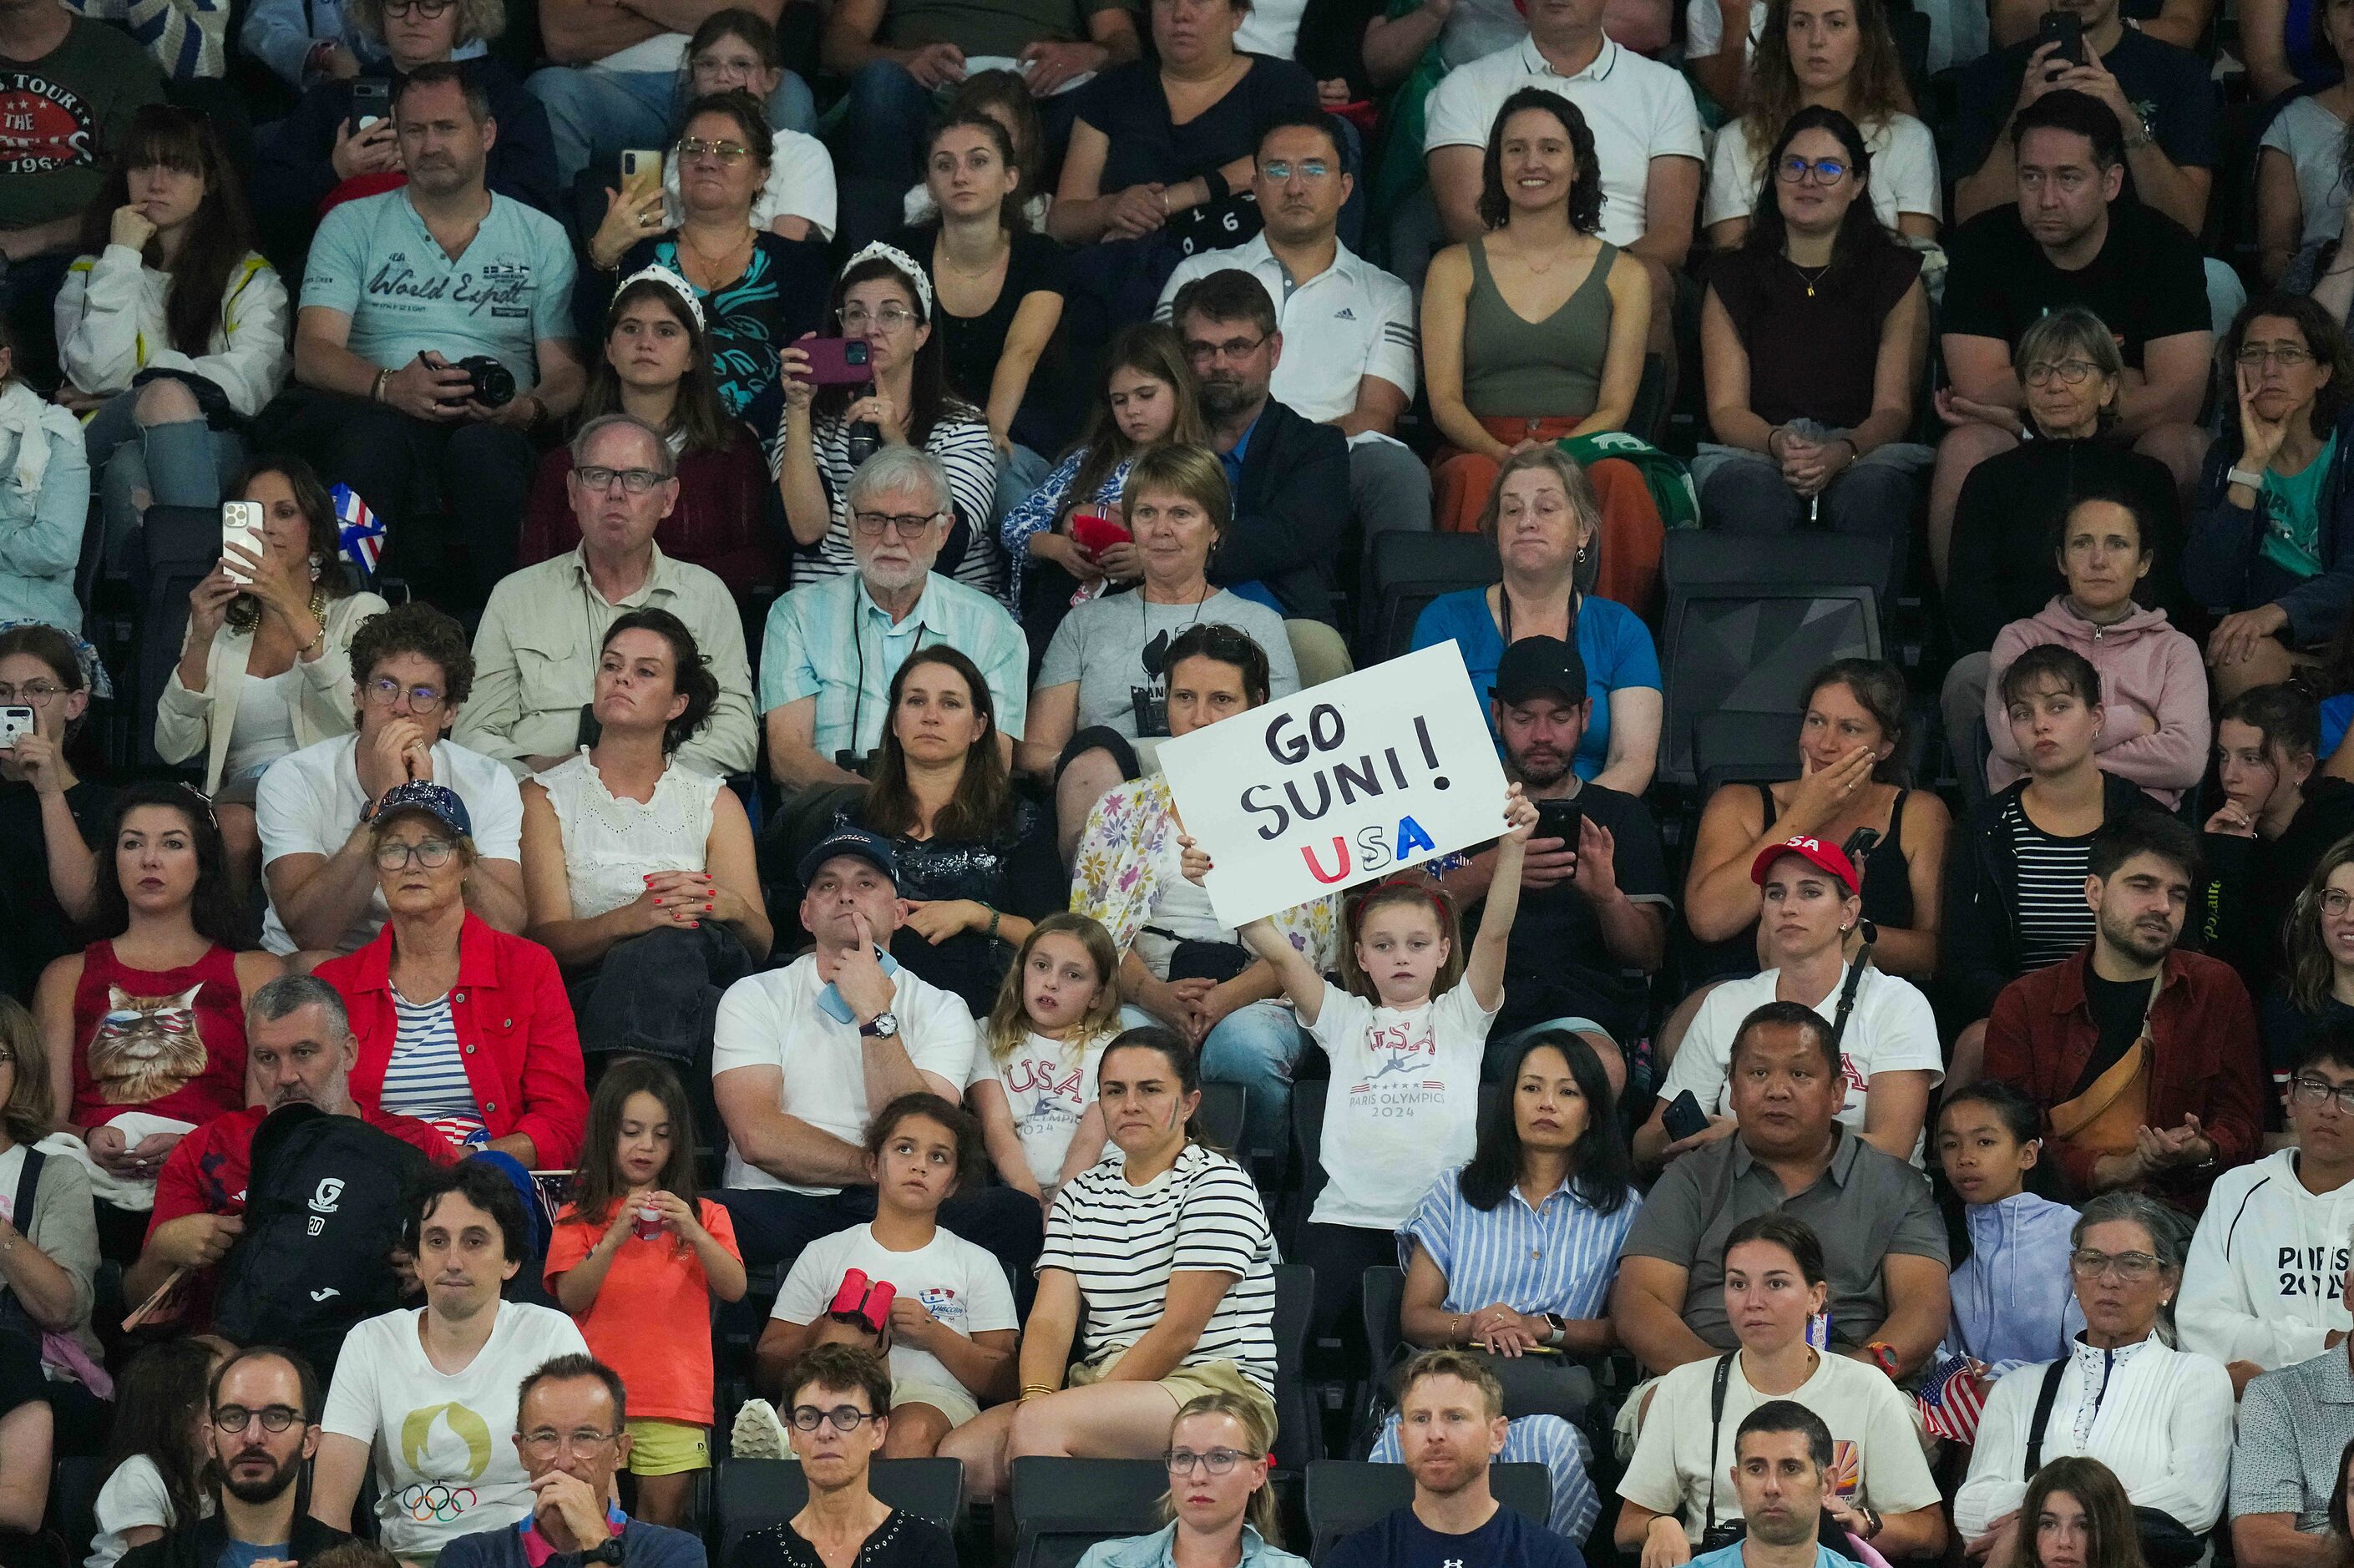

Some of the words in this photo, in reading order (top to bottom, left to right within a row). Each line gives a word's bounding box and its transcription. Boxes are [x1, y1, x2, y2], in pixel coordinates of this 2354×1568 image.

[13, 73, 77, 109] TOUR
[4, 113, 33, 130] THE
[9, 157, 66, 173] 196
[1223, 211, 1239, 231] 6
[1265, 703, 1345, 765] GO
[1300, 815, 1436, 884] USA
[1784, 835, 1820, 852] SA
[1365, 1021, 1435, 1055] USA
[1002, 1058, 1084, 1104] USA
[1349, 1094, 1376, 1107] PARIS
[1380, 1092, 1445, 1104] OLYMPICS
[1371, 1107, 1415, 1117] 2024
[308, 1217, 323, 1234] 20
